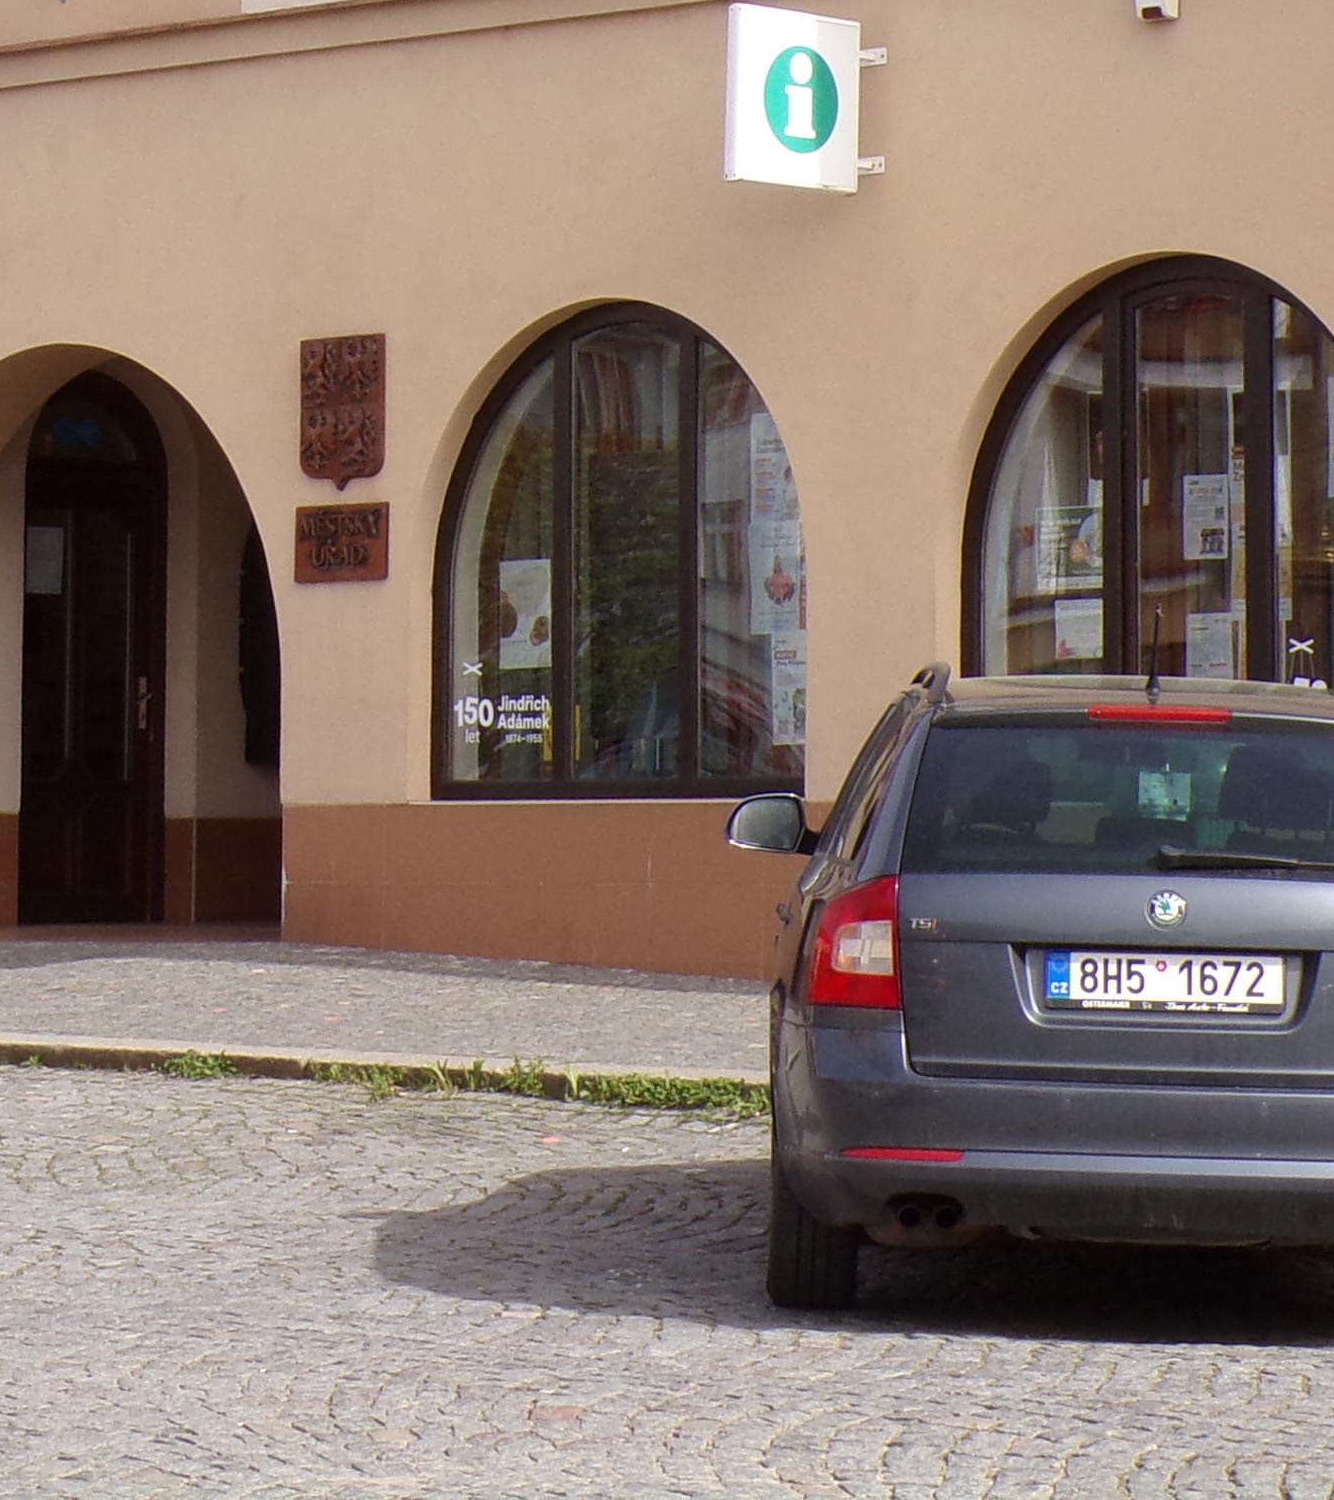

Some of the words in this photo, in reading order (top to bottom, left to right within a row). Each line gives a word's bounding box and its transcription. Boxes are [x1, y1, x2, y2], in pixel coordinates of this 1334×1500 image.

[498, 694, 550, 712] Jindřich
[454, 696, 494, 728] 150
[497, 713, 550, 730] Adámek
[465, 728, 481, 743] let
[910, 917, 938, 930] TSI
[1079, 958, 1146, 994] 8H5
[1178, 959, 1265, 998] 1672
[1050, 982, 1068, 994] CZ
